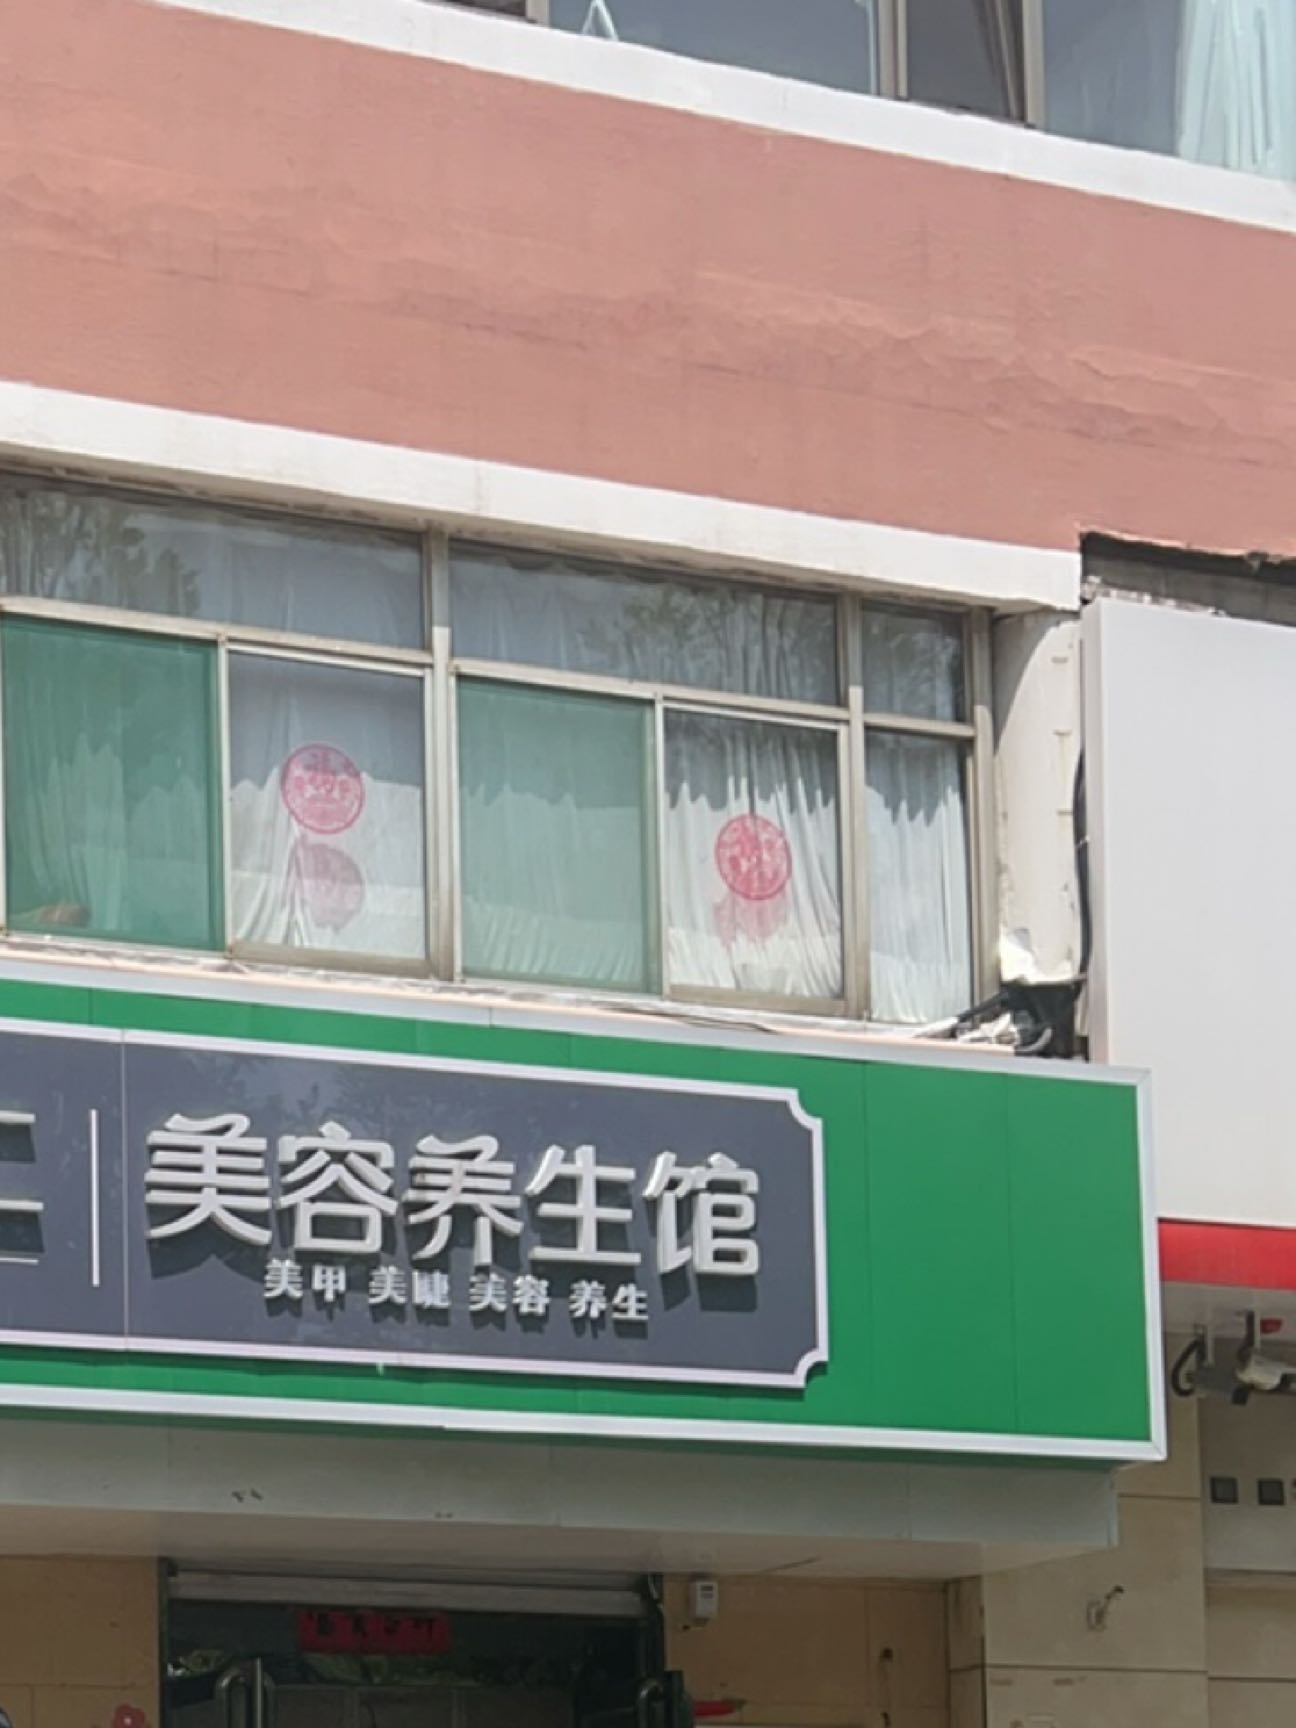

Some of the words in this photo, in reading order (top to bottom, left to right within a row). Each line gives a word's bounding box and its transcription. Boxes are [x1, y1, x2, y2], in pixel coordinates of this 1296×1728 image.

[145, 1112, 760, 1276] 美容养生馆
[263, 1257, 347, 1303] 美甲
[468, 1272, 552, 1318] 美容
[568, 1279, 650, 1322] 养生
